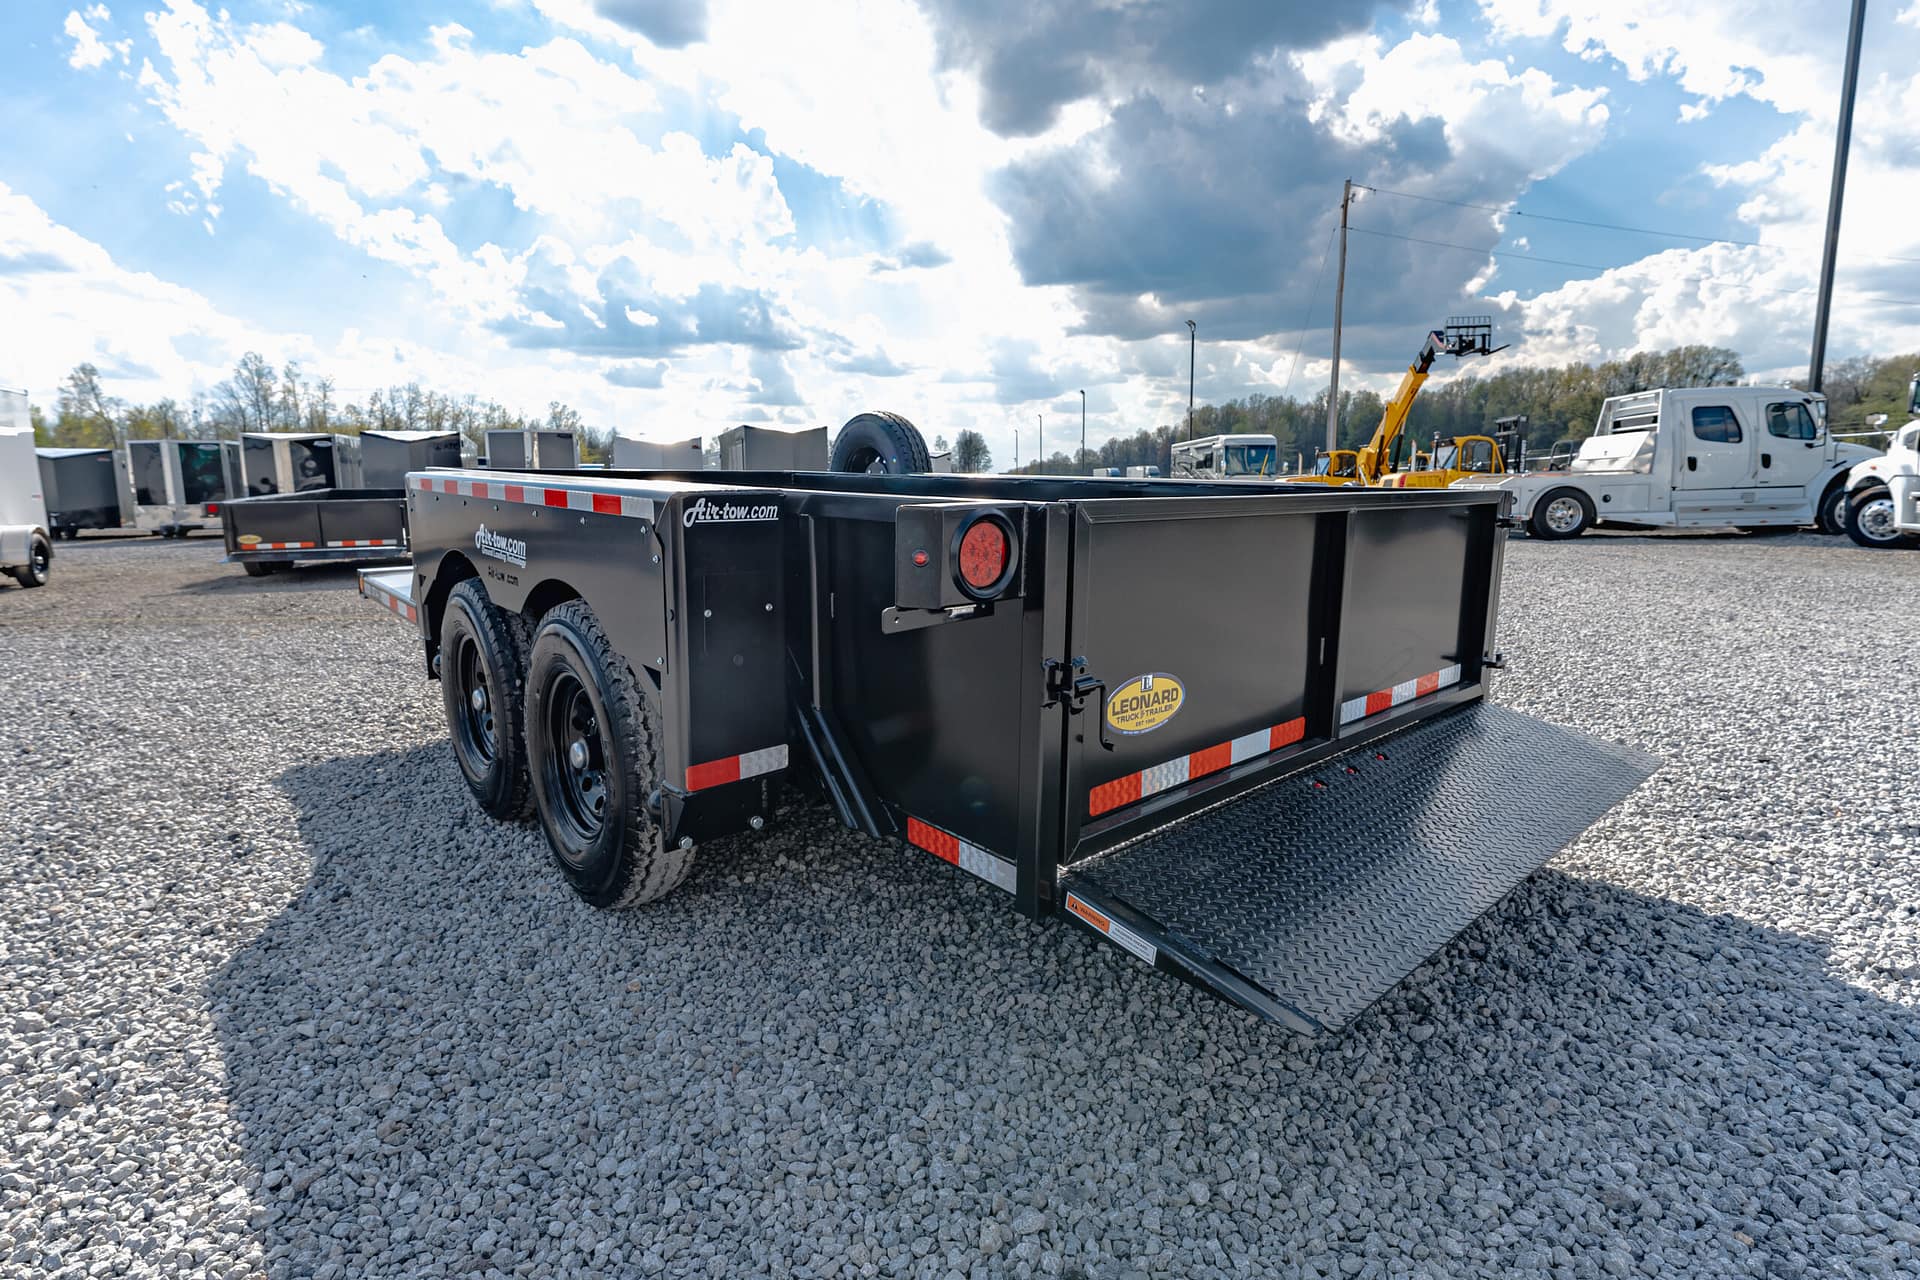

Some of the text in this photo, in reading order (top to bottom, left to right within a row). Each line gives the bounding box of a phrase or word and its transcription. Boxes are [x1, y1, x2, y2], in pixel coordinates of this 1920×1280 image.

[683, 498, 779, 528] Air-tow.com
[475, 523, 526, 556] Air-tow.com
[1111, 687, 1179, 717] LEONARD
[1116, 711, 1140, 724] TRUCK
[1145, 704, 1173, 718] TRAILER
